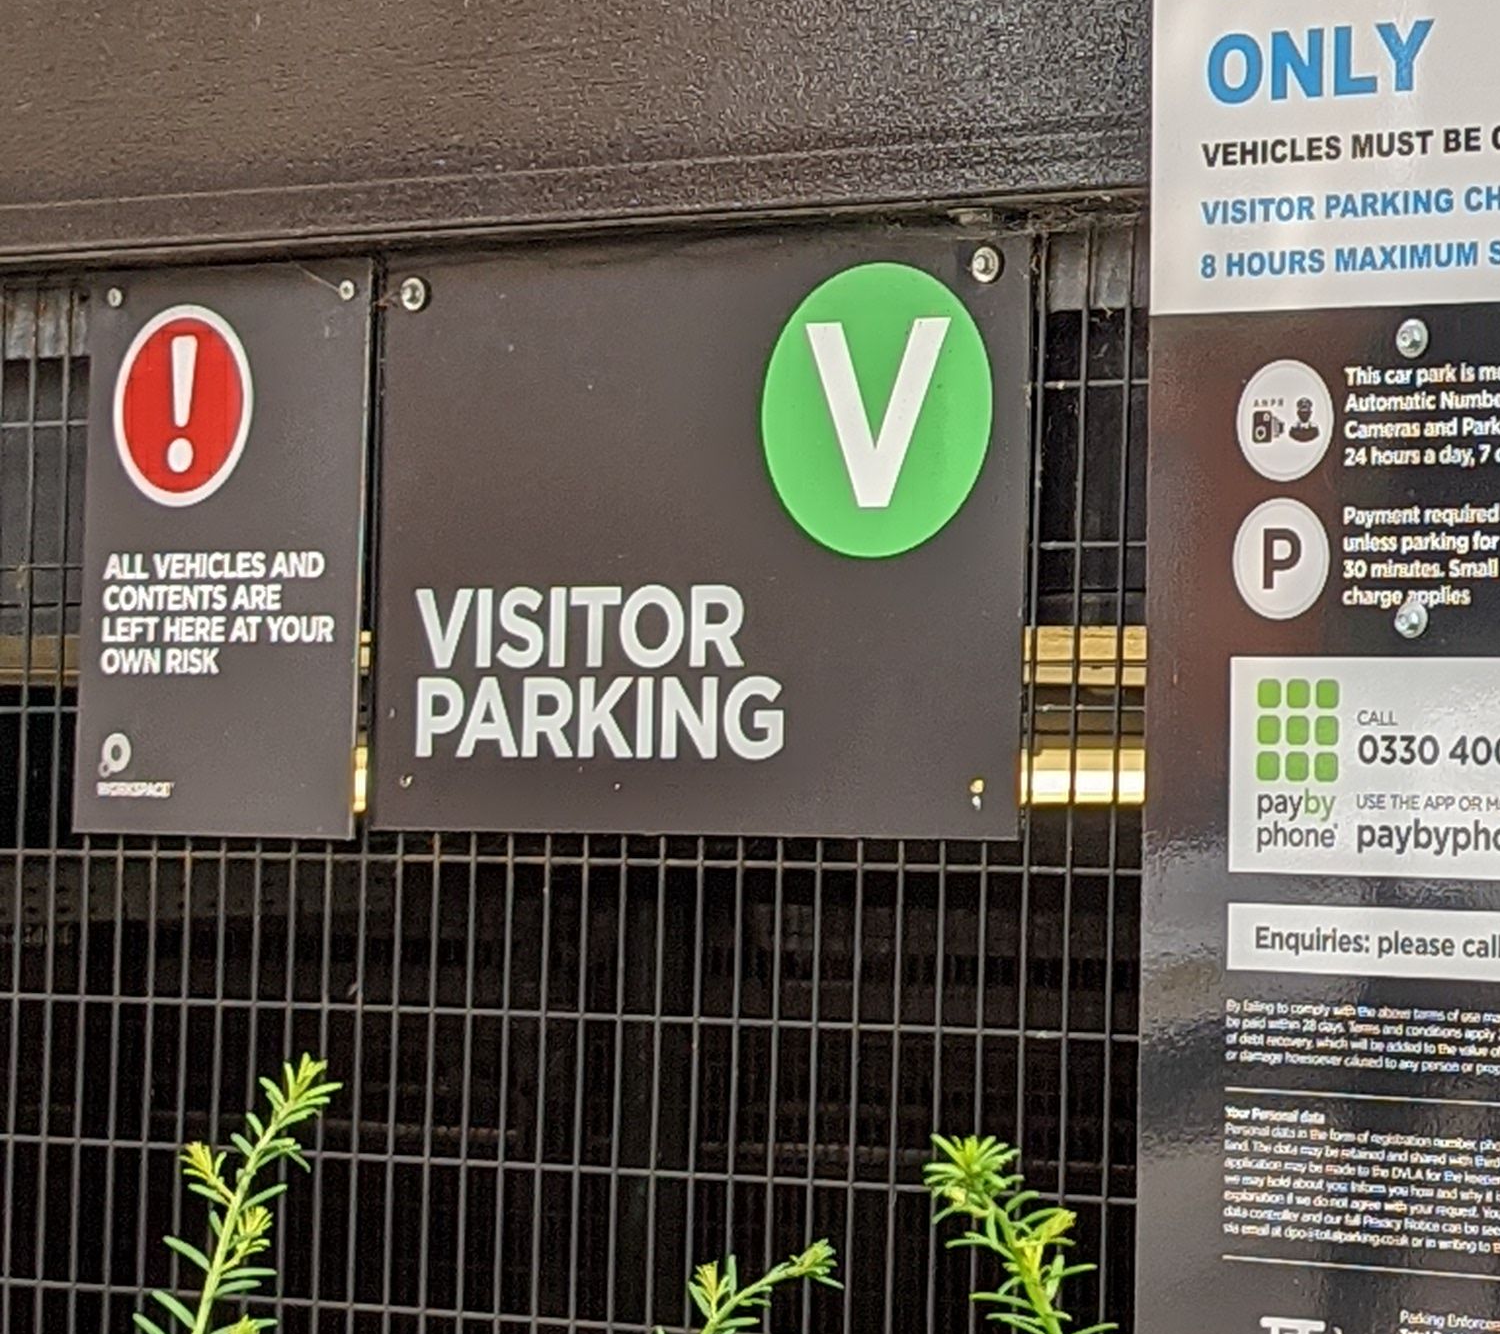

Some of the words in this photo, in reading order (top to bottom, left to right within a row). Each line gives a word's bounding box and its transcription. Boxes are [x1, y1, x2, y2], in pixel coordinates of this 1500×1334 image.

[1207, 18, 1434, 105] ONLY
[1202, 134, 1342, 168] VEHICLES
[1351, 128, 1434, 160] MUST
[1443, 126, 1481, 155] BE
[1201, 195, 1315, 226] VISITOR
[1325, 187, 1454, 220] PARKING
[1200, 253, 1217, 279] 8
[1226, 248, 1325, 278] HOURS
[1335, 241, 1478, 273] MAXIMUM
[1344, 364, 1382, 387] This
[1384, 367, 1413, 386] car
[1415, 362, 1457, 388] park
[1460, 362, 1476, 383] is
[805, 316, 952, 508] V
[1344, 389, 1437, 414] Automatic
[1344, 419, 1421, 440] Cameras
[1423, 416, 1458, 438] and
[1343, 446, 1368, 467] 24
[1370, 445, 1421, 467] hours
[1423, 447, 1436, 465] a
[1438, 443, 1476, 468] day,
[1478, 443, 1491, 464] 7
[1343, 505, 1421, 529] Payment
[1423, 502, 1500, 528] required
[103, 553, 150, 581] ALL
[152, 550, 267, 581] VEHICLES
[269, 550, 325, 579] AND
[1262, 527, 1303, 590] P
[102, 583, 228, 613] CONTENTS
[230, 582, 282, 612] ARE
[101, 615, 160, 643] LEFT
[163, 615, 227, 643] HERE
[228, 615, 263, 643] AT
[266, 615, 335, 644] YOUR
[415, 583, 745, 670] VISITOR
[100, 647, 161, 675] OWN
[165, 646, 219, 675] RISK
[415, 675, 784, 761] PARKING
[1356, 709, 1399, 728] CALL
[1358, 734, 1440, 766] 0330
[1255, 925, 1370, 957] Enquiries:
[1377, 929, 1455, 960] please
